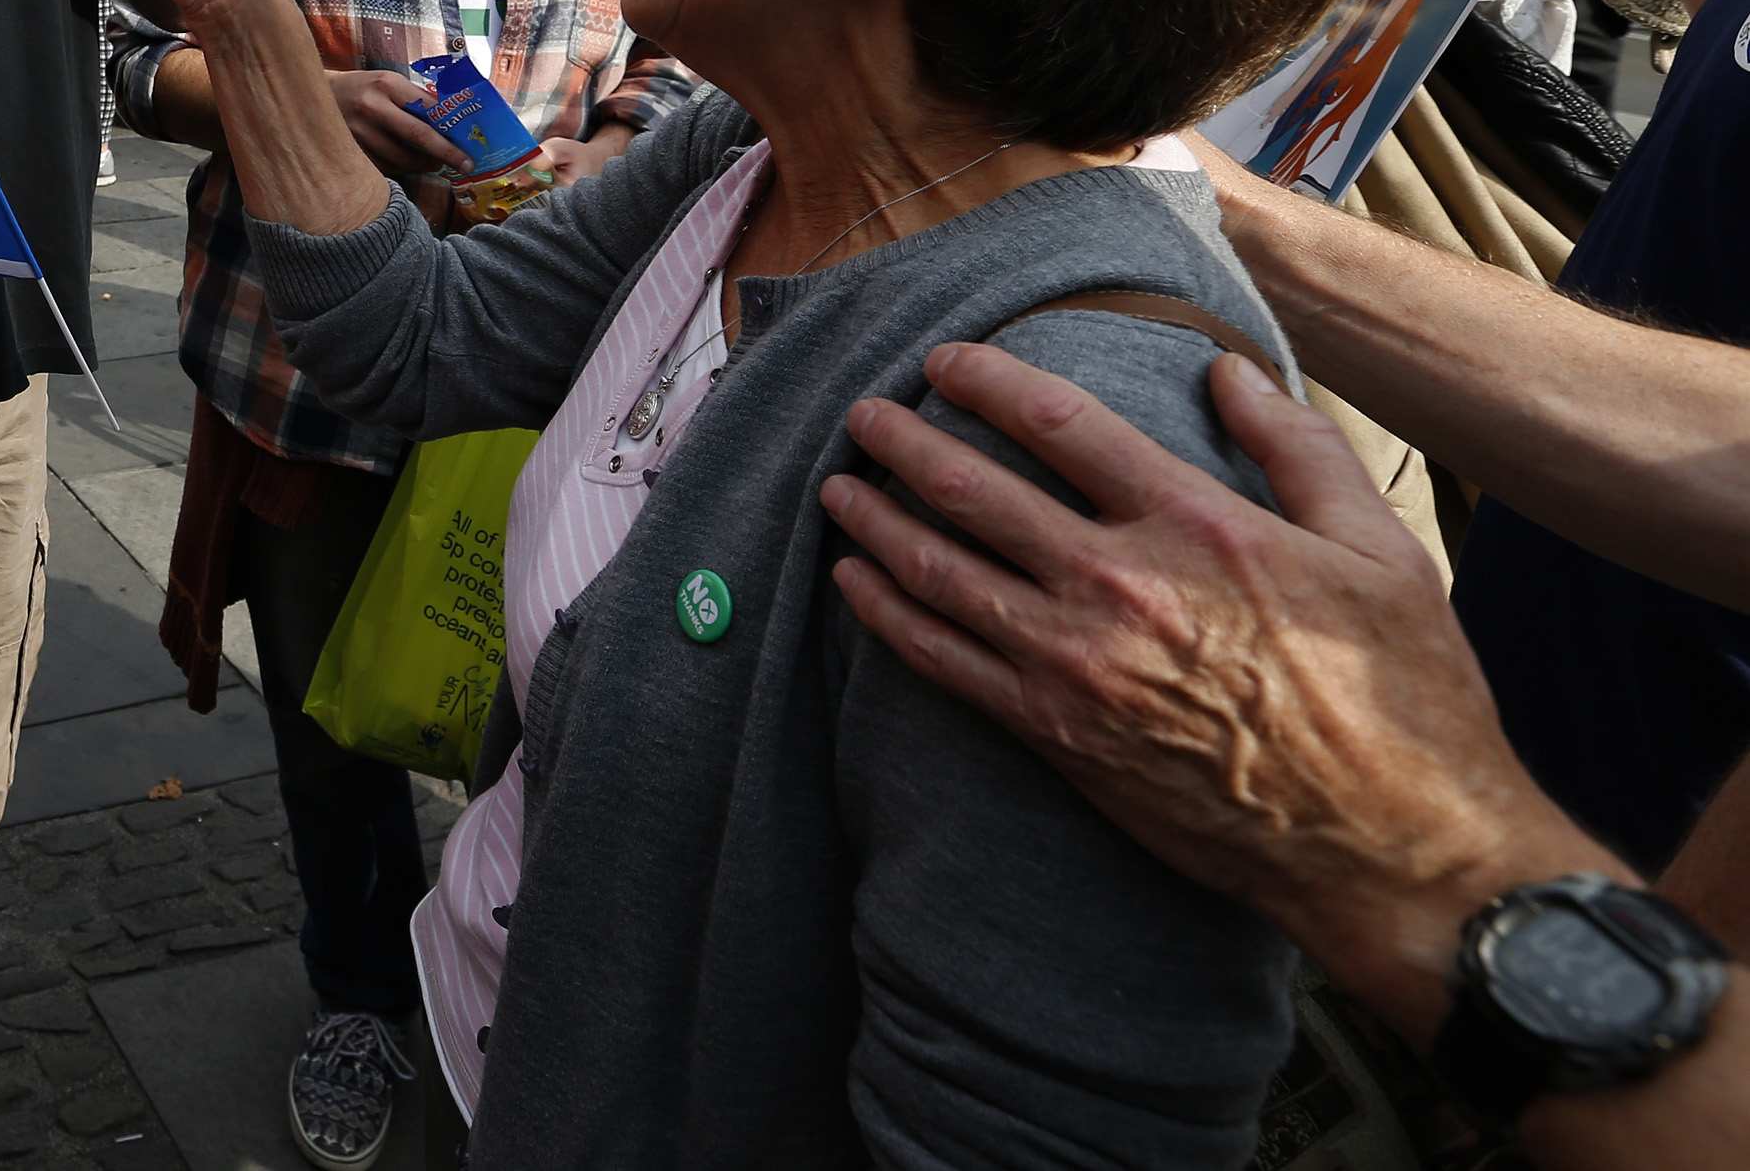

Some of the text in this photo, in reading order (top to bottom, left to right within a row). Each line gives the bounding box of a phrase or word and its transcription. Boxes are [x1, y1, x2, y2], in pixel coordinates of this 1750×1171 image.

[427, 87, 476, 123] HARIBO
[438, 99, 483, 133] Starmix
[441, 532, 464, 558] 5p
[452, 510, 499, 548] All of
[679, 588, 705, 635] THANKS
